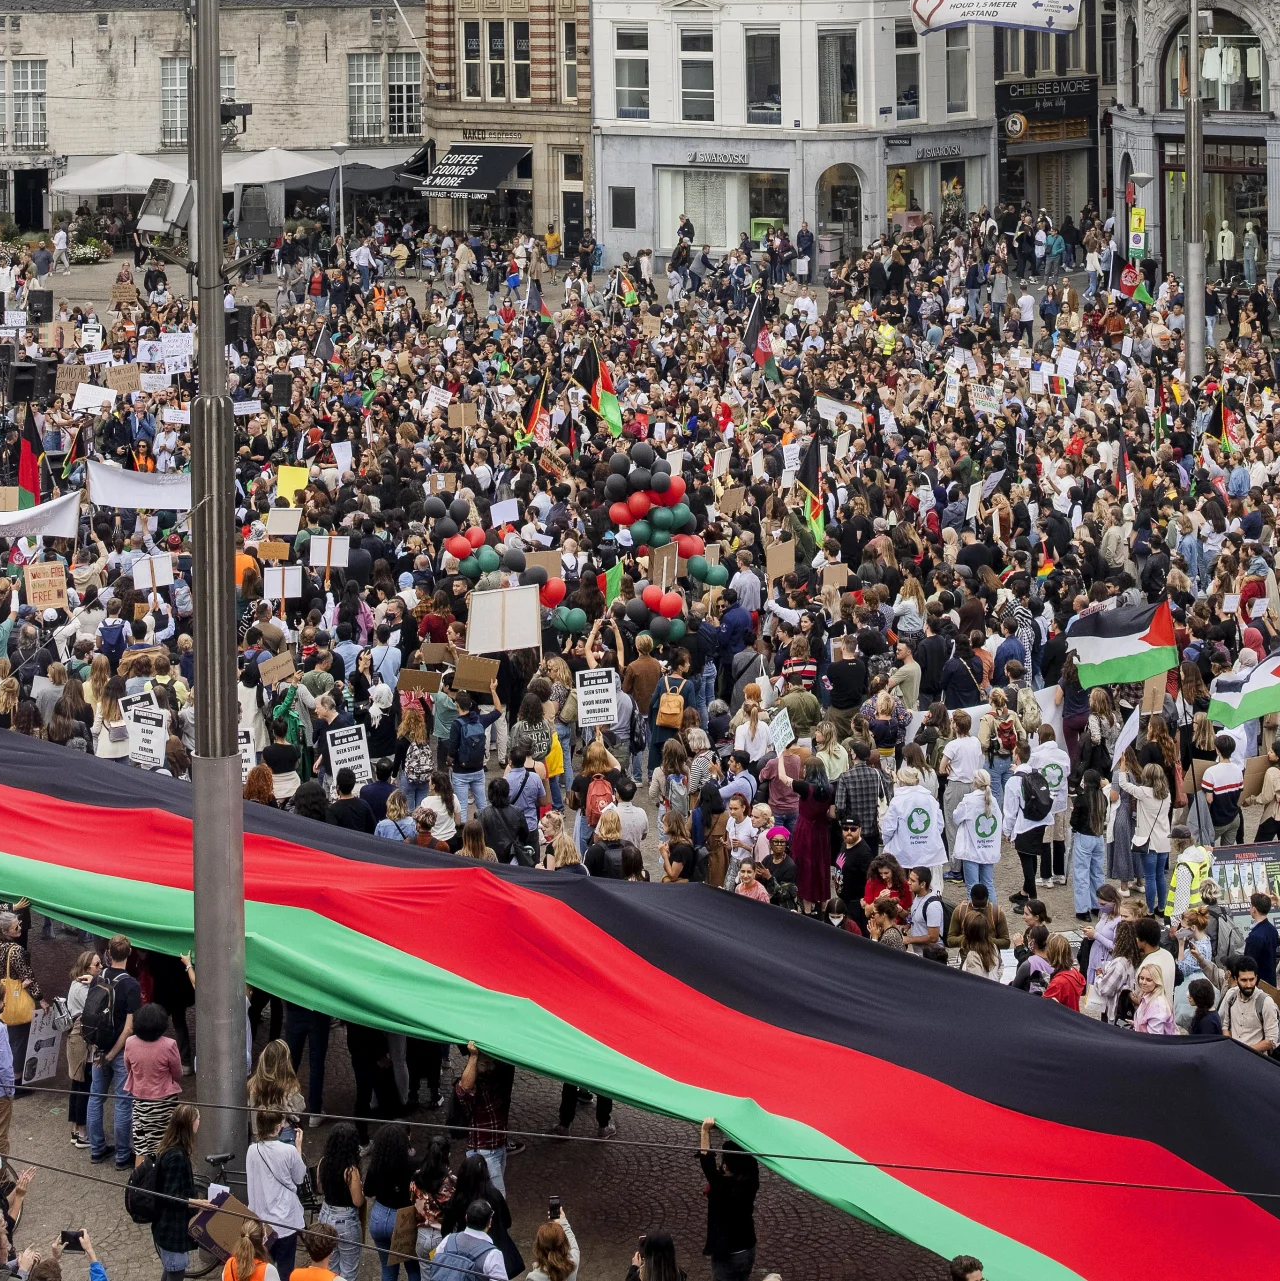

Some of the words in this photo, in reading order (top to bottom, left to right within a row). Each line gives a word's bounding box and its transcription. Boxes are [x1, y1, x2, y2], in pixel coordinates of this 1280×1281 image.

[949, 2, 974, 10] HOUD
[960, 10, 999, 18] AFSTAND
[462, 128, 486, 141] NAKED
[488, 131, 522, 141] espresso
[926, 146, 961, 158] SWAROVSKI
[441, 154, 484, 165] COFFEE
[698, 152, 749, 164] SWAROVSKI
[431, 165, 478, 176] COOKIES
[422, 176, 433, 186] &
[432, 177, 465, 187] MORE
[421, 190, 447, 198] BREAKFAST
[972, 384, 986, 394] STOP
[32, 589, 52, 603] FREE
[582, 699, 595, 707] VOOR
[586, 707, 610, 715] OORLOGEN
[336, 747, 347, 755] GEEN
[347, 744, 361, 753] STEUN
[335, 757, 348, 766] VOOR
[348, 754, 365, 763] NIEUWE
